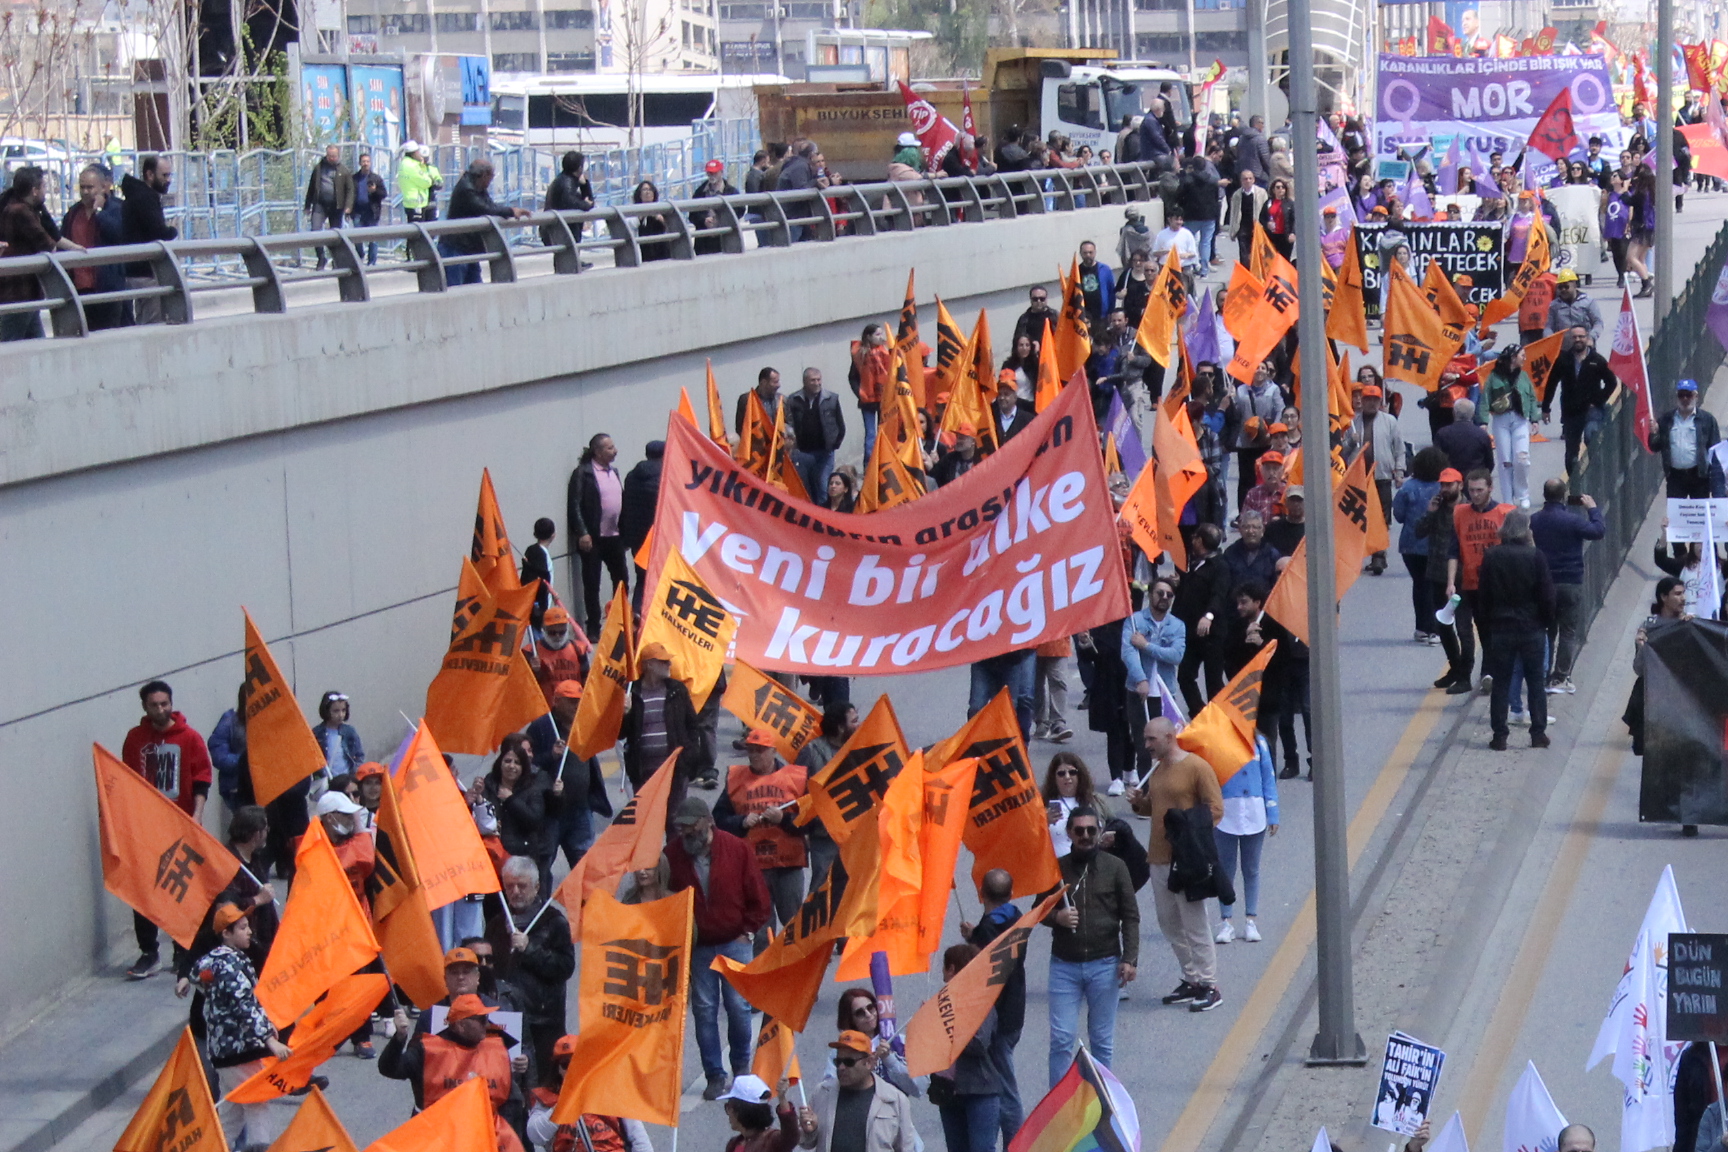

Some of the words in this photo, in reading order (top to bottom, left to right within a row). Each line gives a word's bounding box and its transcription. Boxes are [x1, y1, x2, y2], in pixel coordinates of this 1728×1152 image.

[1380, 59, 1475, 75] KARANLIKLAR
[1477, 56, 1527, 76] İÇİNDE
[1529, 56, 1551, 70] BİR
[1553, 58, 1578, 72] IŞIK
[1579, 57, 1604, 71] VAR
[1451, 80, 1534, 119] MOR
[1360, 231, 1476, 251] KAINLAR
[848, 552, 948, 607] bir
[764, 545, 1106, 669] kuracağız
[661, 609, 714, 652] HALKEVLERİ
[1674, 940, 1712, 962] DÜN
[1675, 966, 1722, 988] BUGÜN
[1672, 992, 1717, 1015] YARIN
[1388, 1041, 1435, 1069] TAHİR'İN
[443, 1075, 498, 1091] İNSCA
